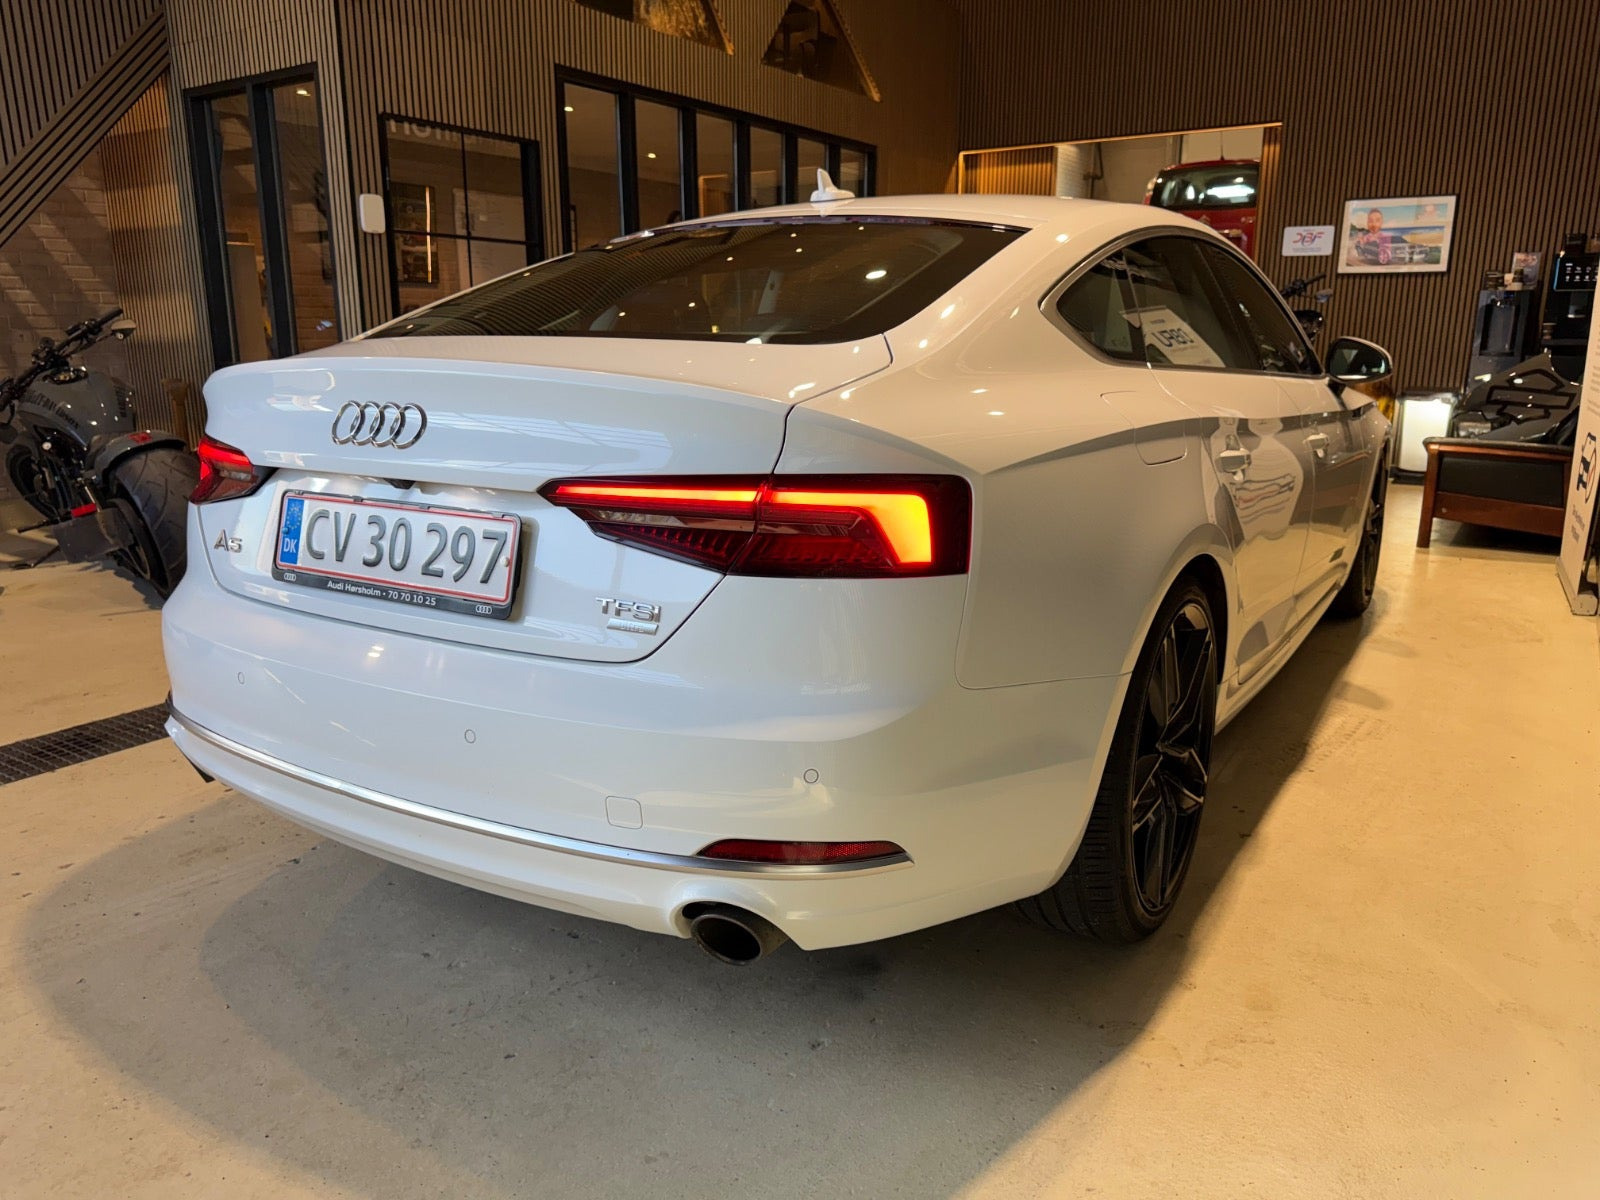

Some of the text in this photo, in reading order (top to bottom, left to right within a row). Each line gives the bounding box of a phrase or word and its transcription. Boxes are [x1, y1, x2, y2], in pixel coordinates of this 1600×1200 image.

[214, 528, 243, 553] A5
[283, 537, 298, 554] DK
[306, 509, 508, 584] CV 30 297
[327, 580, 437, 606] Audi Hørsholm 70 70 10 25
